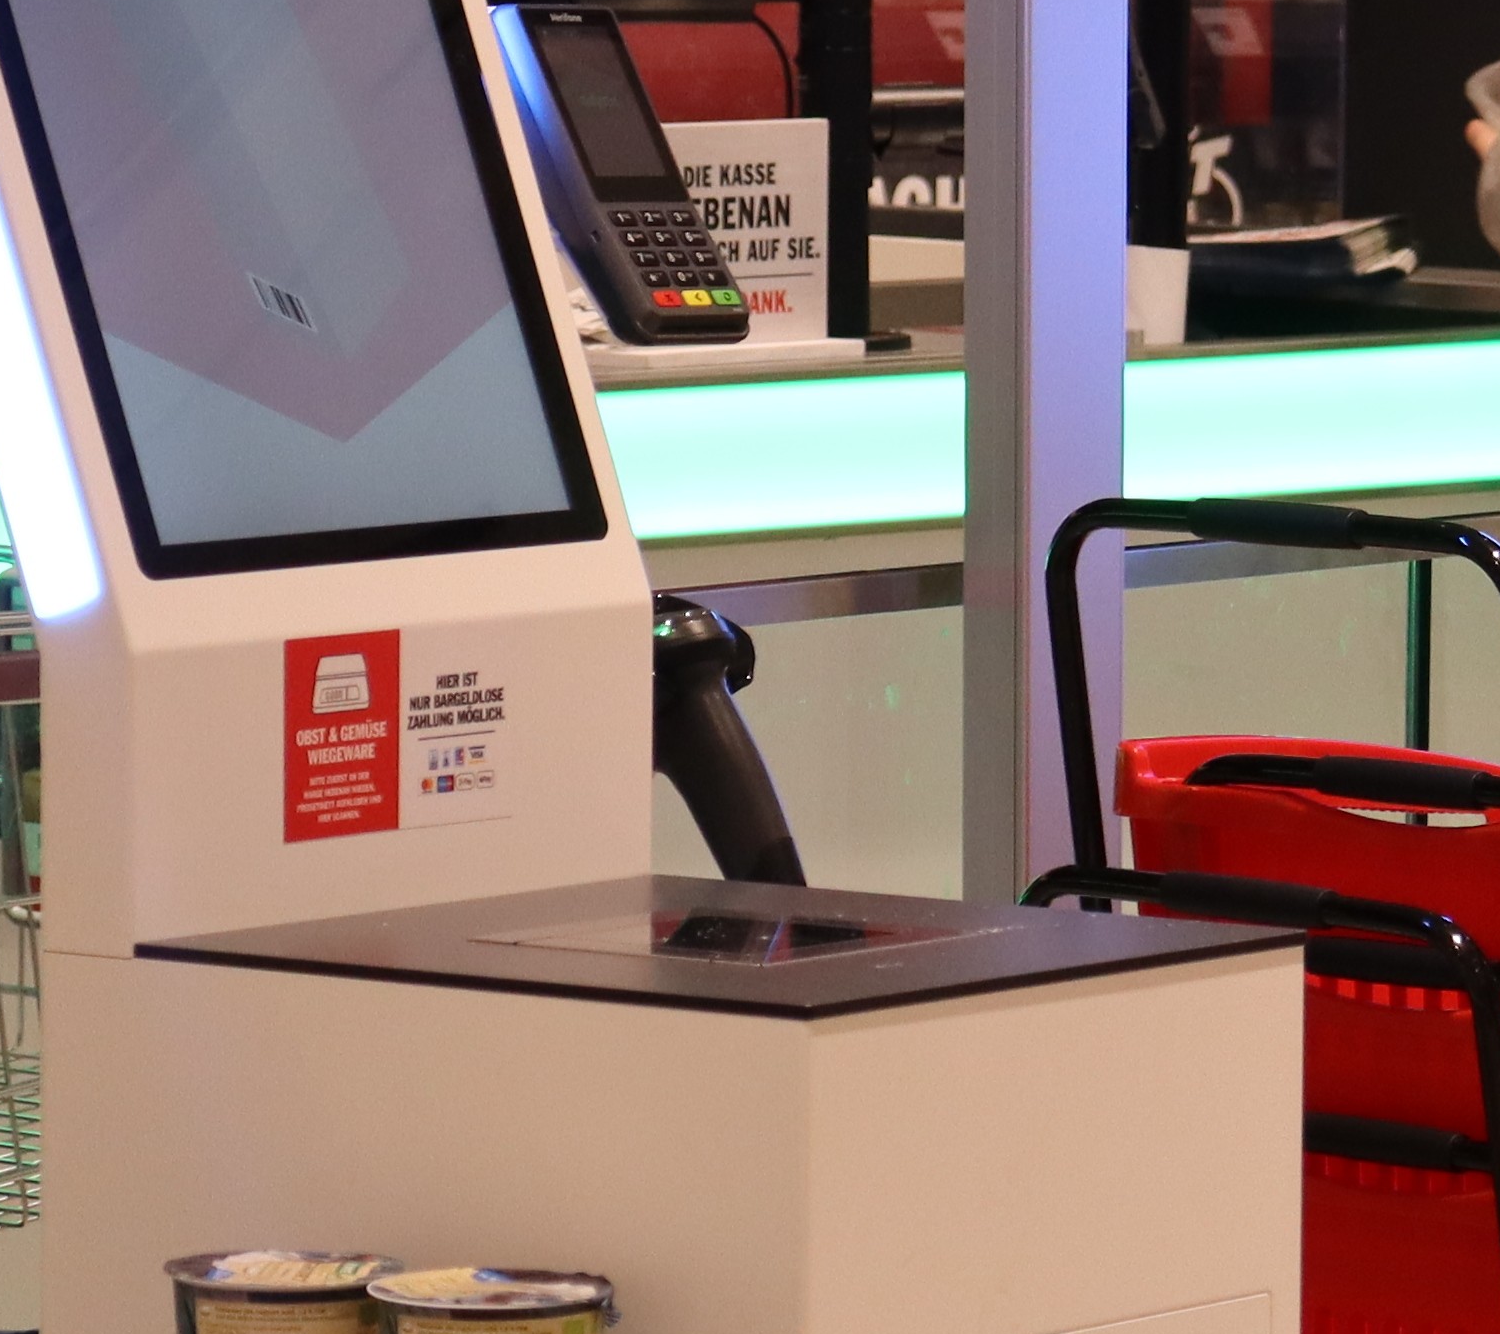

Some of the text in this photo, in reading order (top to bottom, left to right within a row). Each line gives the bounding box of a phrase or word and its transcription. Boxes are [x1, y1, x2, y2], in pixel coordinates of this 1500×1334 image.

[684, 163, 776, 188] DIE KASSE
[692, 194, 790, 230] BENAN
[747, 238, 781, 261] AUF
[787, 235, 821, 261] SIE.
[436, 672, 478, 690] HIER IST
[409, 687, 504, 711] NUR BARGELDLOSE
[408, 707, 505, 731] ZAHLUNG MÖGLICH.
[296, 720, 387, 747] OBST & GEMÜSE
[308, 742, 376, 766] WIEGEWARE
